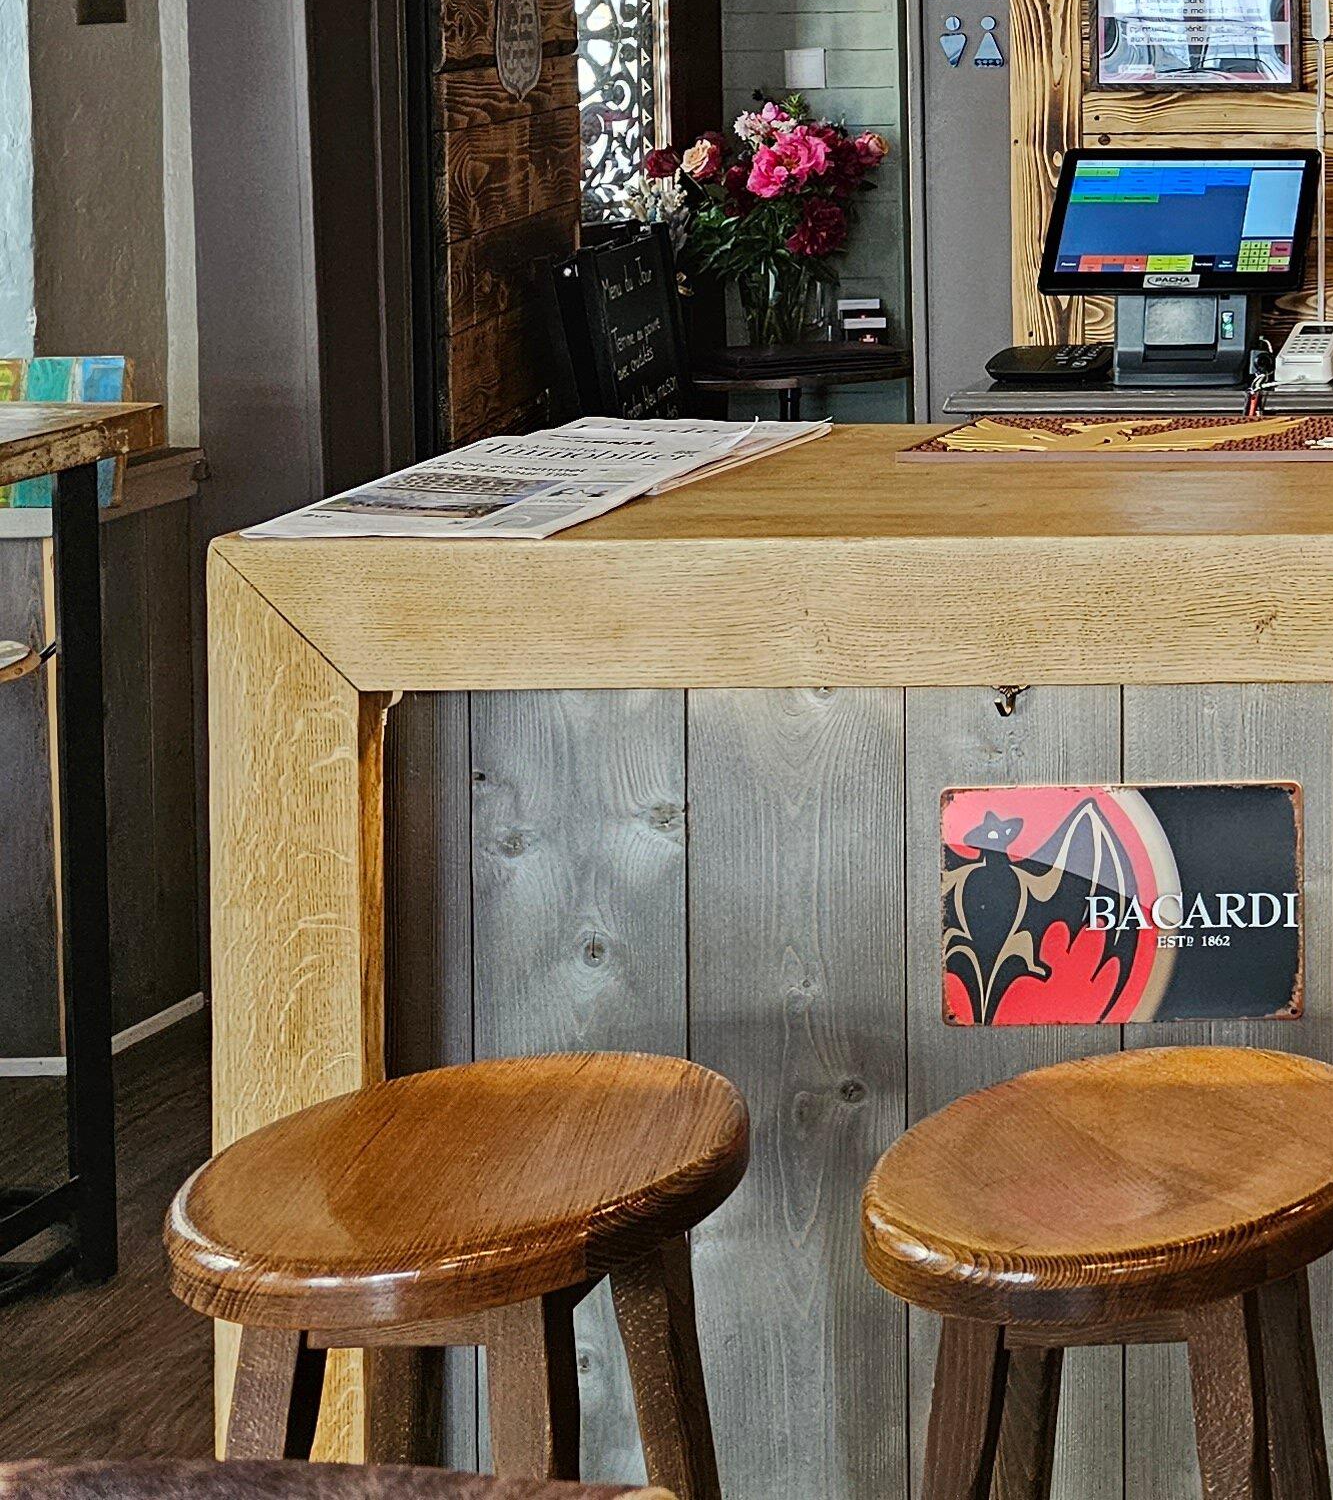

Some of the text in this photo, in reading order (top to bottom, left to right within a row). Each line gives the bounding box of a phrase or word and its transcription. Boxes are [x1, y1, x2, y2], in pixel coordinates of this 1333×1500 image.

[1154, 276, 1191, 285] PACHA
[1085, 892, 1299, 932] BACARDI
[1201, 935, 1230, 947] 1862
